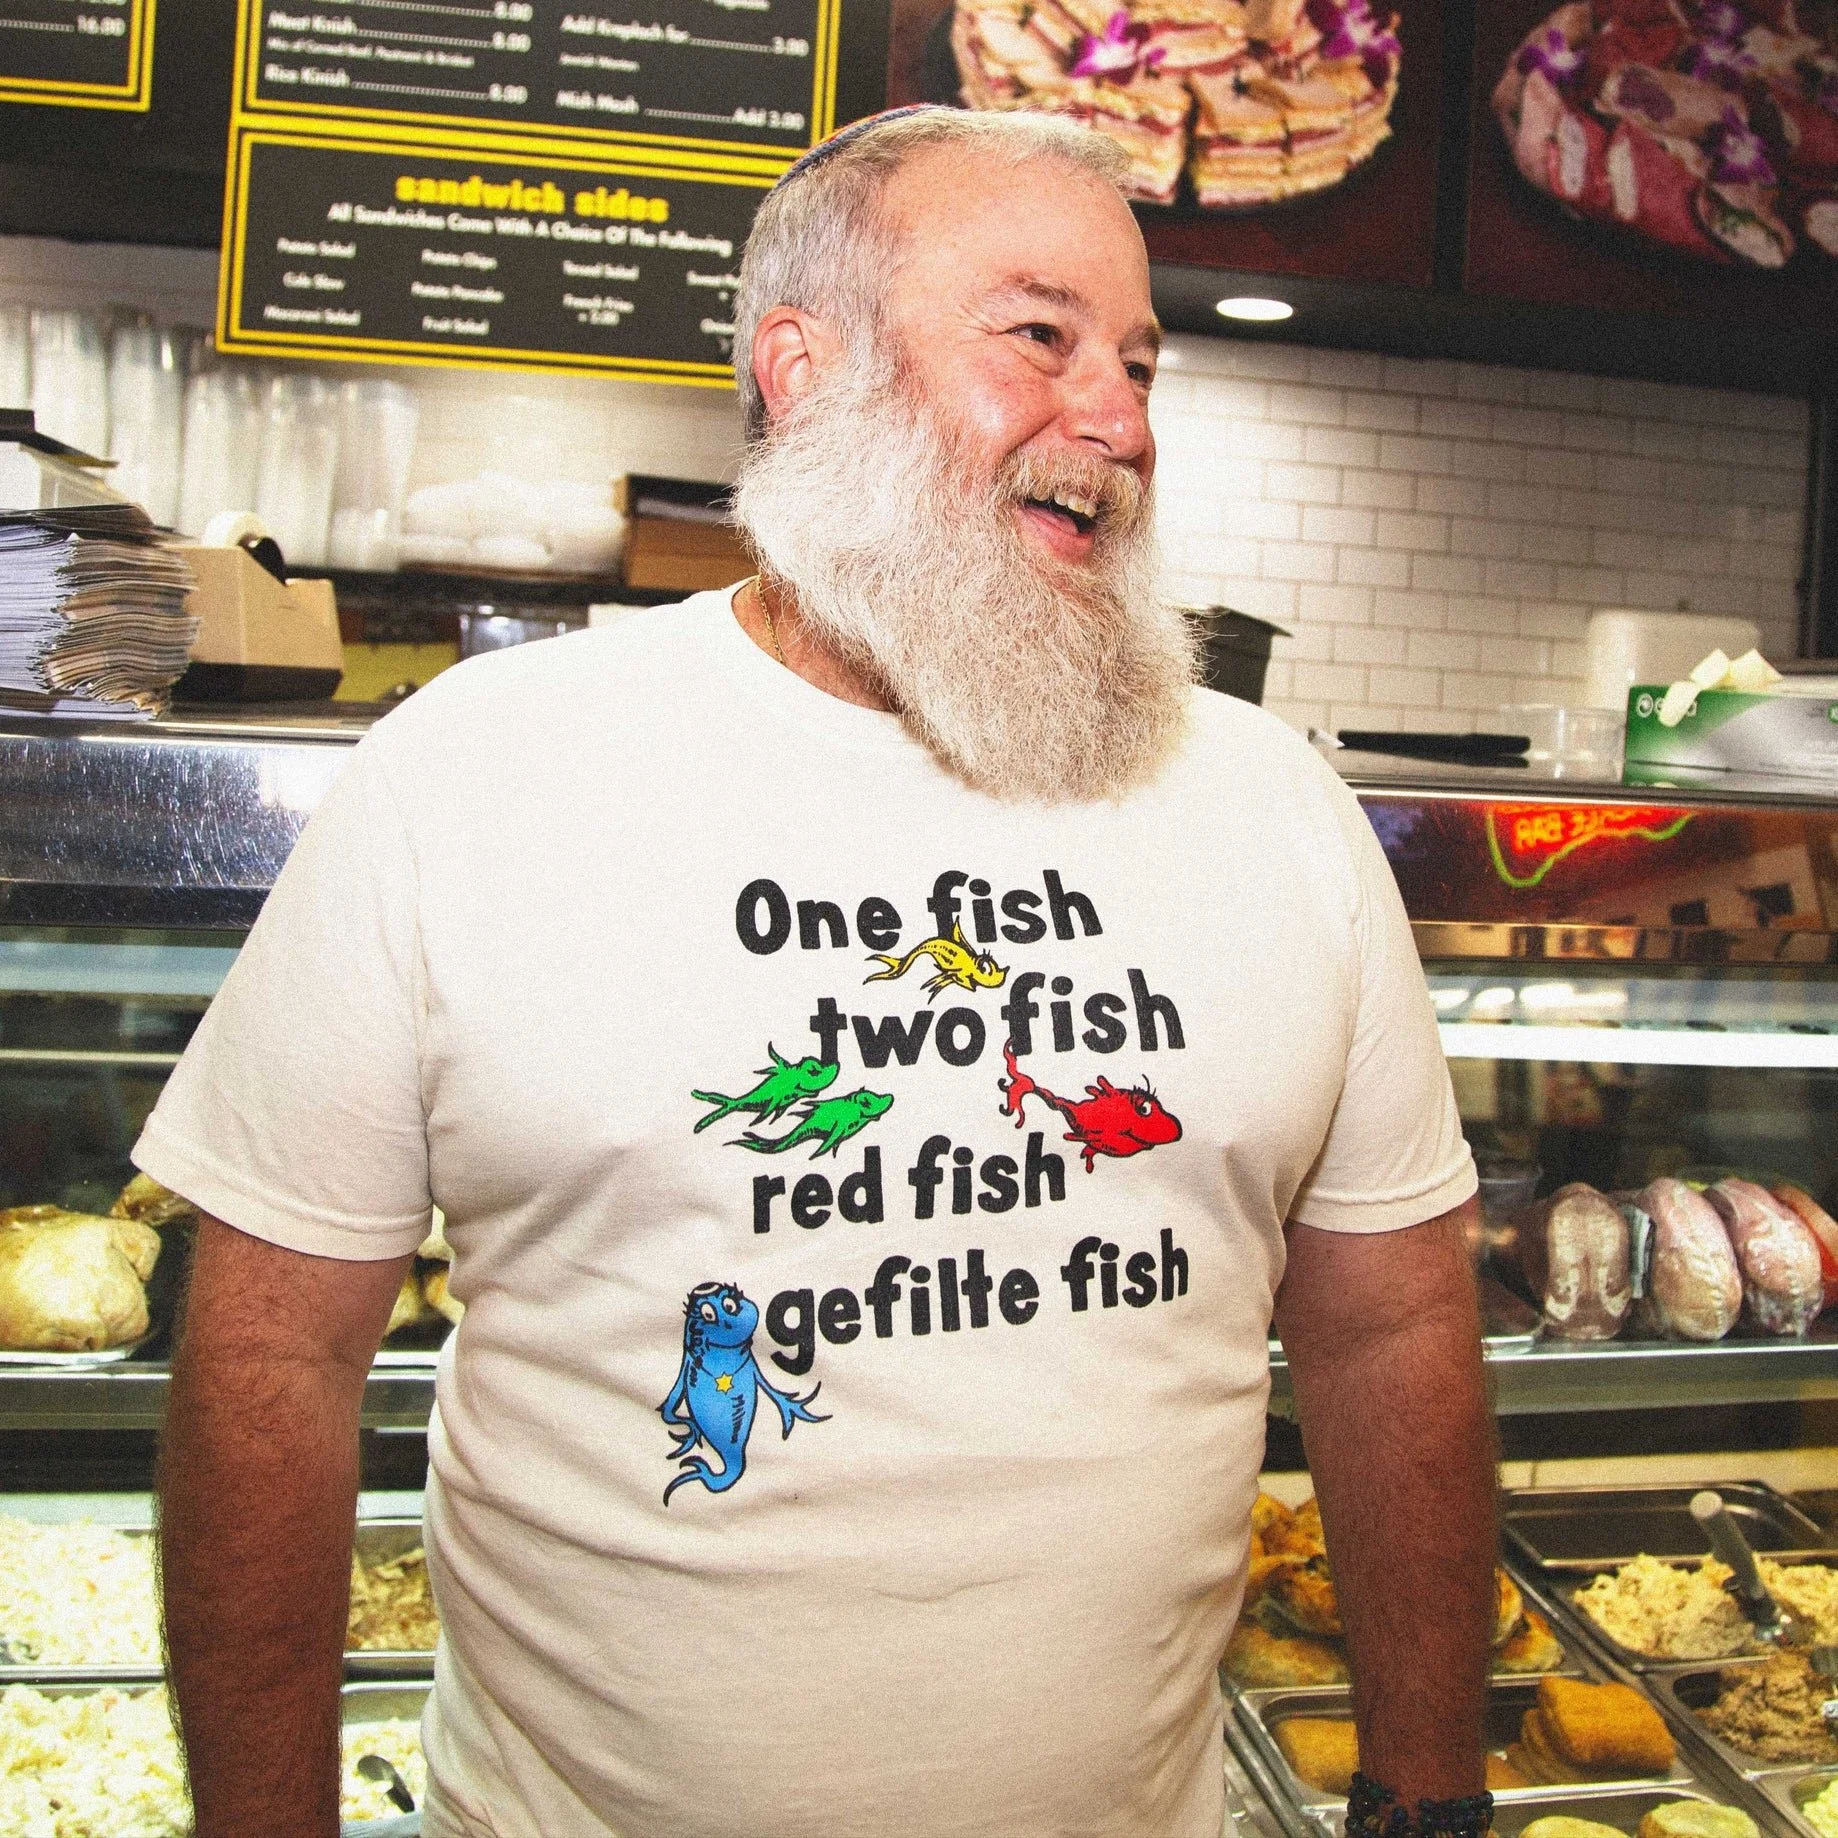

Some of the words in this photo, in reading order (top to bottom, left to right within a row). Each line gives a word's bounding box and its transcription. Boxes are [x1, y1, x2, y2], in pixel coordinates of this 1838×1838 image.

[560, 14, 596, 34] Add
[771, 36, 809, 57] 3.00
[732, 106, 767, 128] Add
[767, 110, 805, 131] 3.00
[395, 176, 565, 214] sandwich
[574, 186, 669, 224] sides
[327, 202, 352, 222] All
[353, 204, 446, 230] Sandwiches
[447, 212, 494, 234] Come
[494, 217, 534, 237] With
[534, 220, 549, 238] A
[550, 220, 604, 243] Choice
[604, 225, 628, 245] Of
[629, 226, 657, 247] The
[658, 230, 733, 258] Following
[276, 237, 318, 256] Potato
[319, 240, 357, 259] Salad
[421, 248, 462, 267] Potato
[604, 263, 640, 281] Salad
[411, 281, 450, 299] Potato
[323, 307, 361, 326] Salad
[451, 317, 490, 336] Salad
[735, 878, 902, 955] One
[927, 869, 1103, 944] fish
[809, 997, 986, 1068] two
[1001, 968, 1186, 1056] fish
[753, 1147, 884, 1234] red
[909, 1131, 1066, 1219] fish
[766, 1248, 1039, 1375] gefilte
[1061, 1228, 1188, 1312] fish
